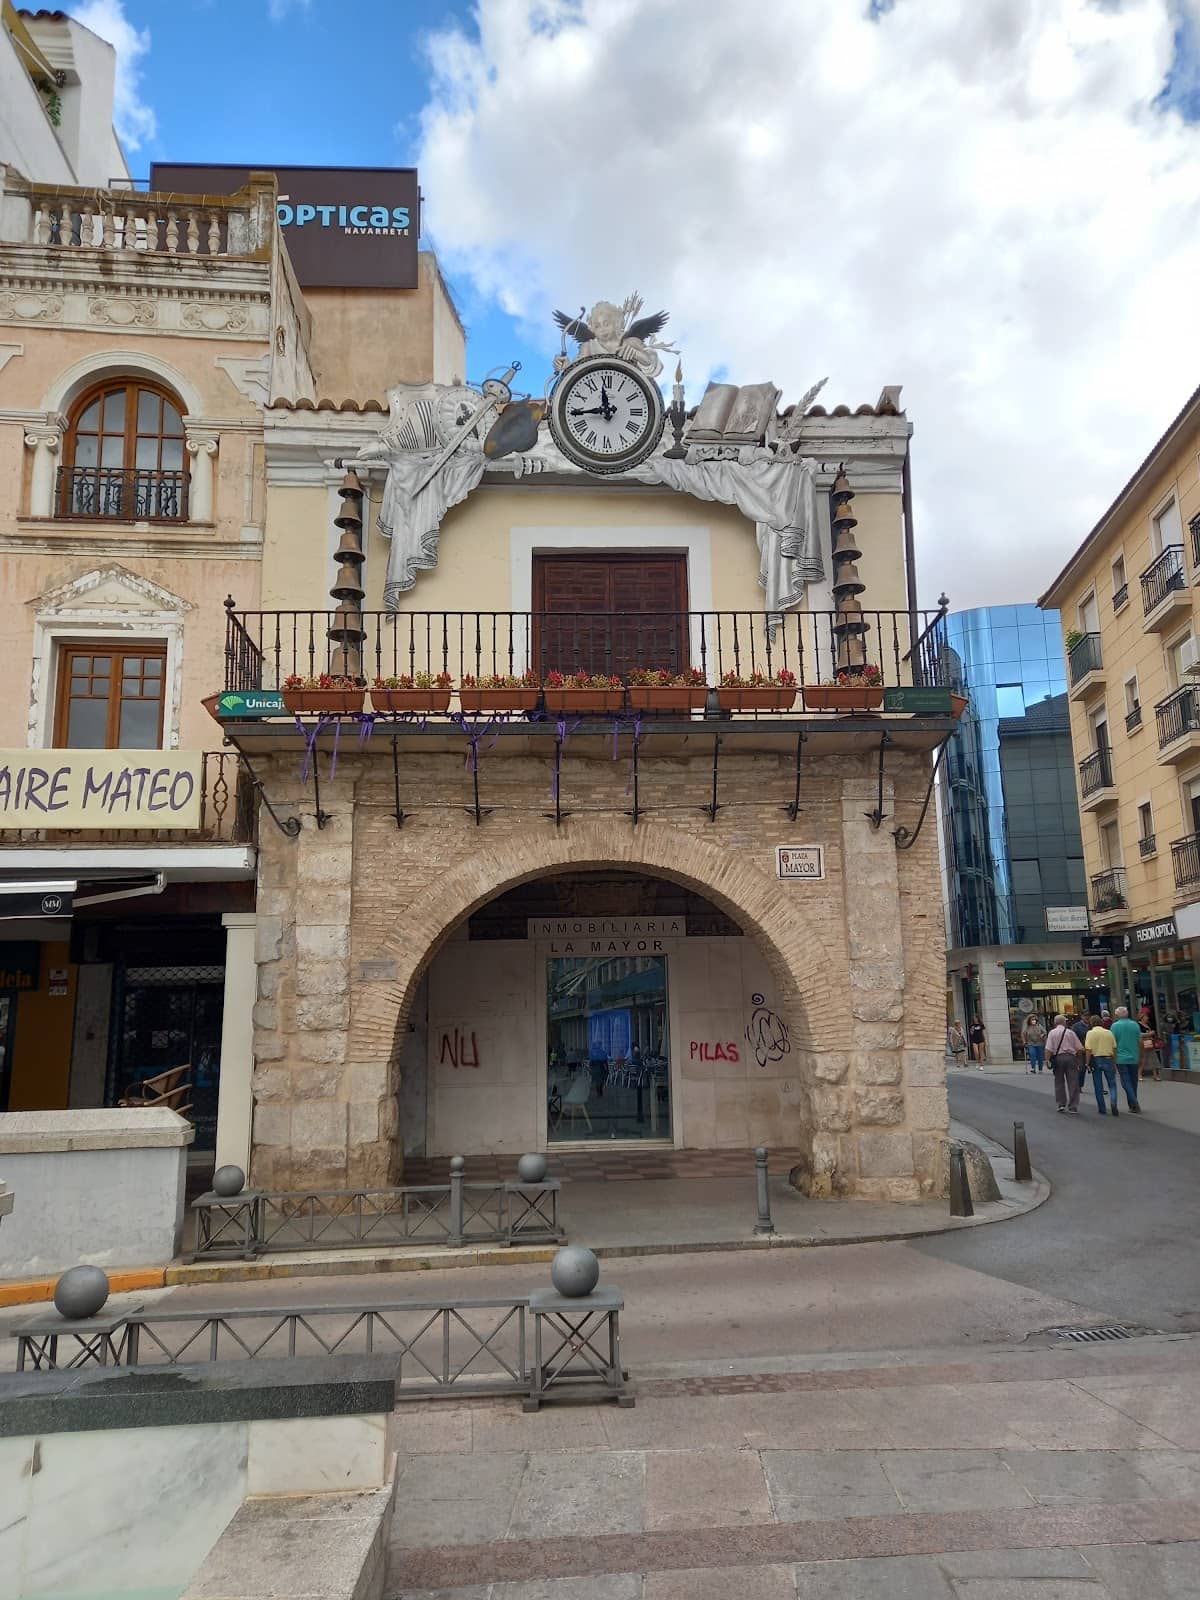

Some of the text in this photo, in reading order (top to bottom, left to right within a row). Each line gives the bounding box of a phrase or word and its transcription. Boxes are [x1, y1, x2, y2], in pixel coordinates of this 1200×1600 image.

[344, 228, 409, 236] NAVARRETE
[82, 766, 194, 813] MATEO
[791, 852, 809, 860] PLAZA
[785, 863, 815, 873] MAYOR
[532, 920, 680, 935] INMOBILIARIA
[1136, 926, 1156, 942] FUSION
[551, 940, 664, 953] LA MAYOR
[690, 1041, 740, 1063] PILAS
